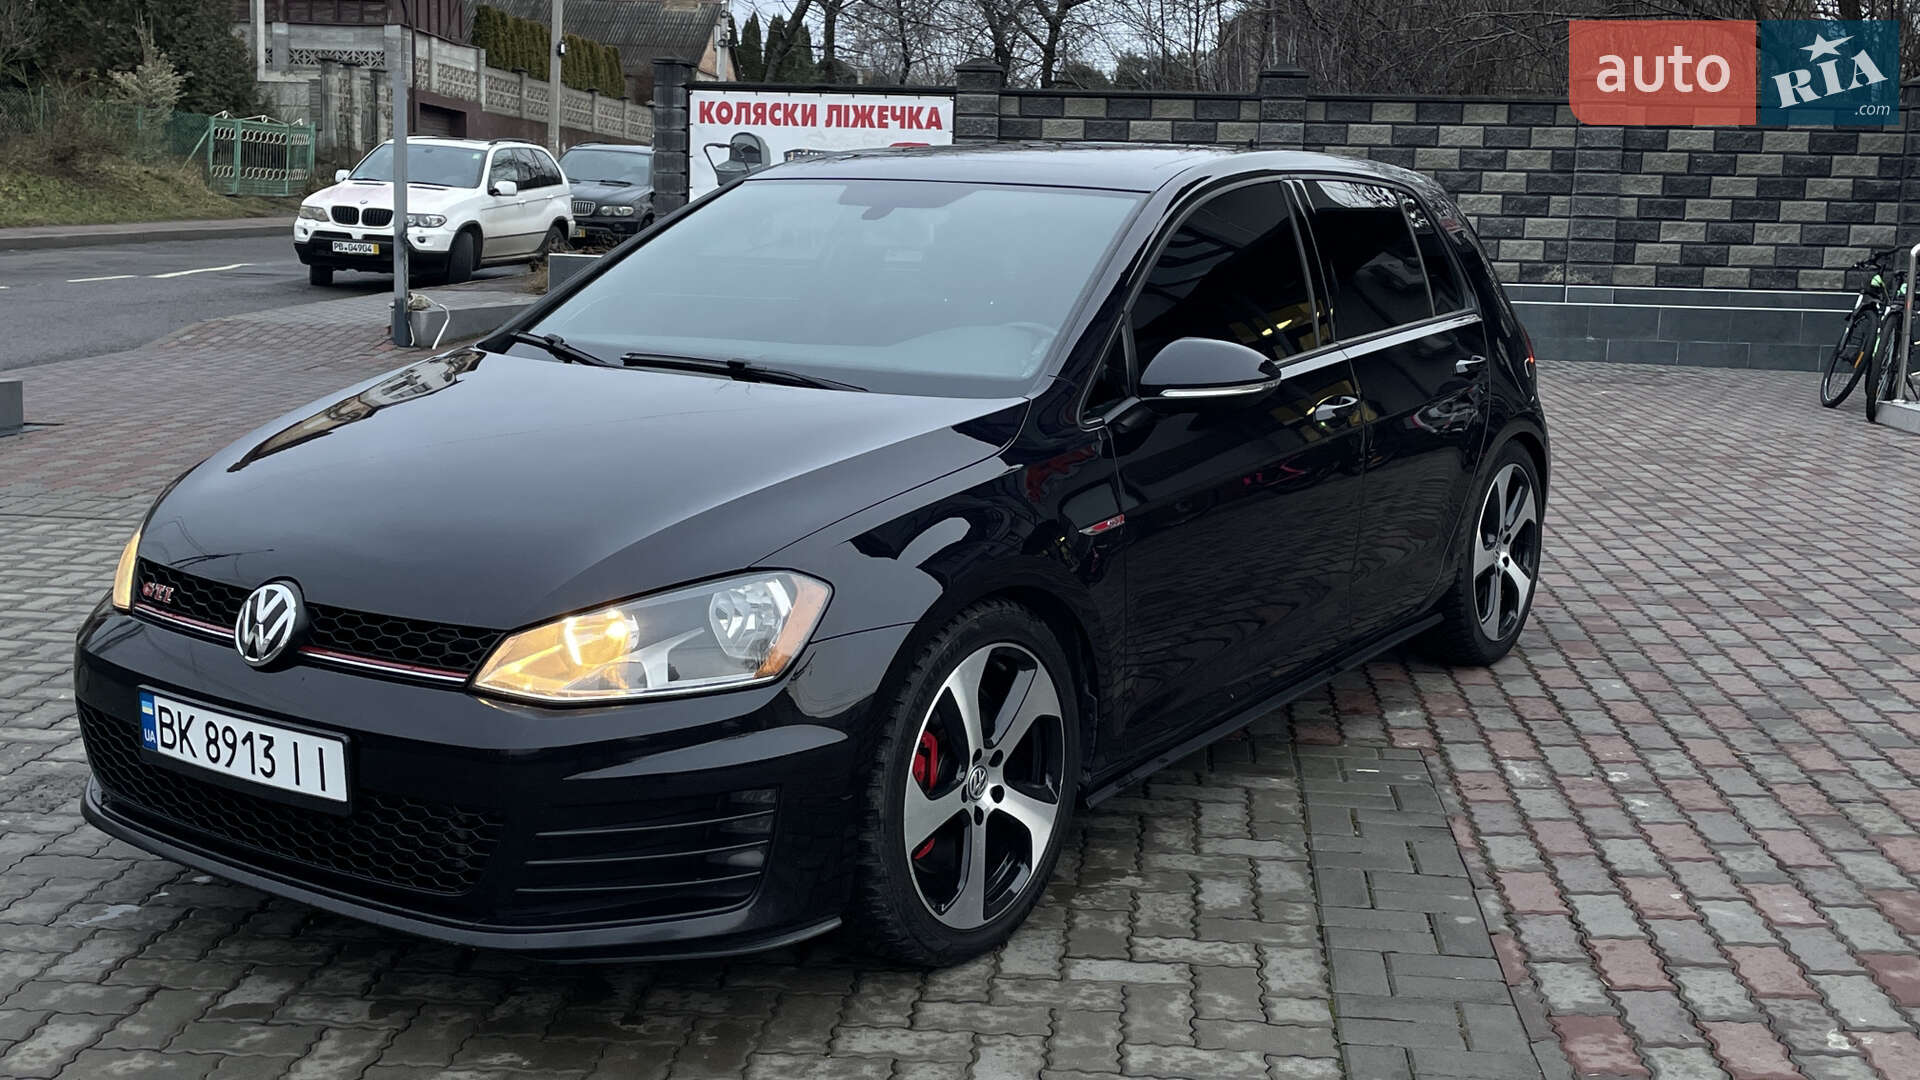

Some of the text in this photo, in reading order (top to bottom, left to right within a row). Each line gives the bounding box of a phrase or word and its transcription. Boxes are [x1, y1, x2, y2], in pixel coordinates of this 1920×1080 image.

[699, 101, 943, 130] КОЛЯСКИ ЛІЖЕЧКА
[143, 582, 174, 604] GTI
[144, 731, 156, 744] UA
[157, 704, 198, 758] BK
[205, 720, 276, 778] 8913
